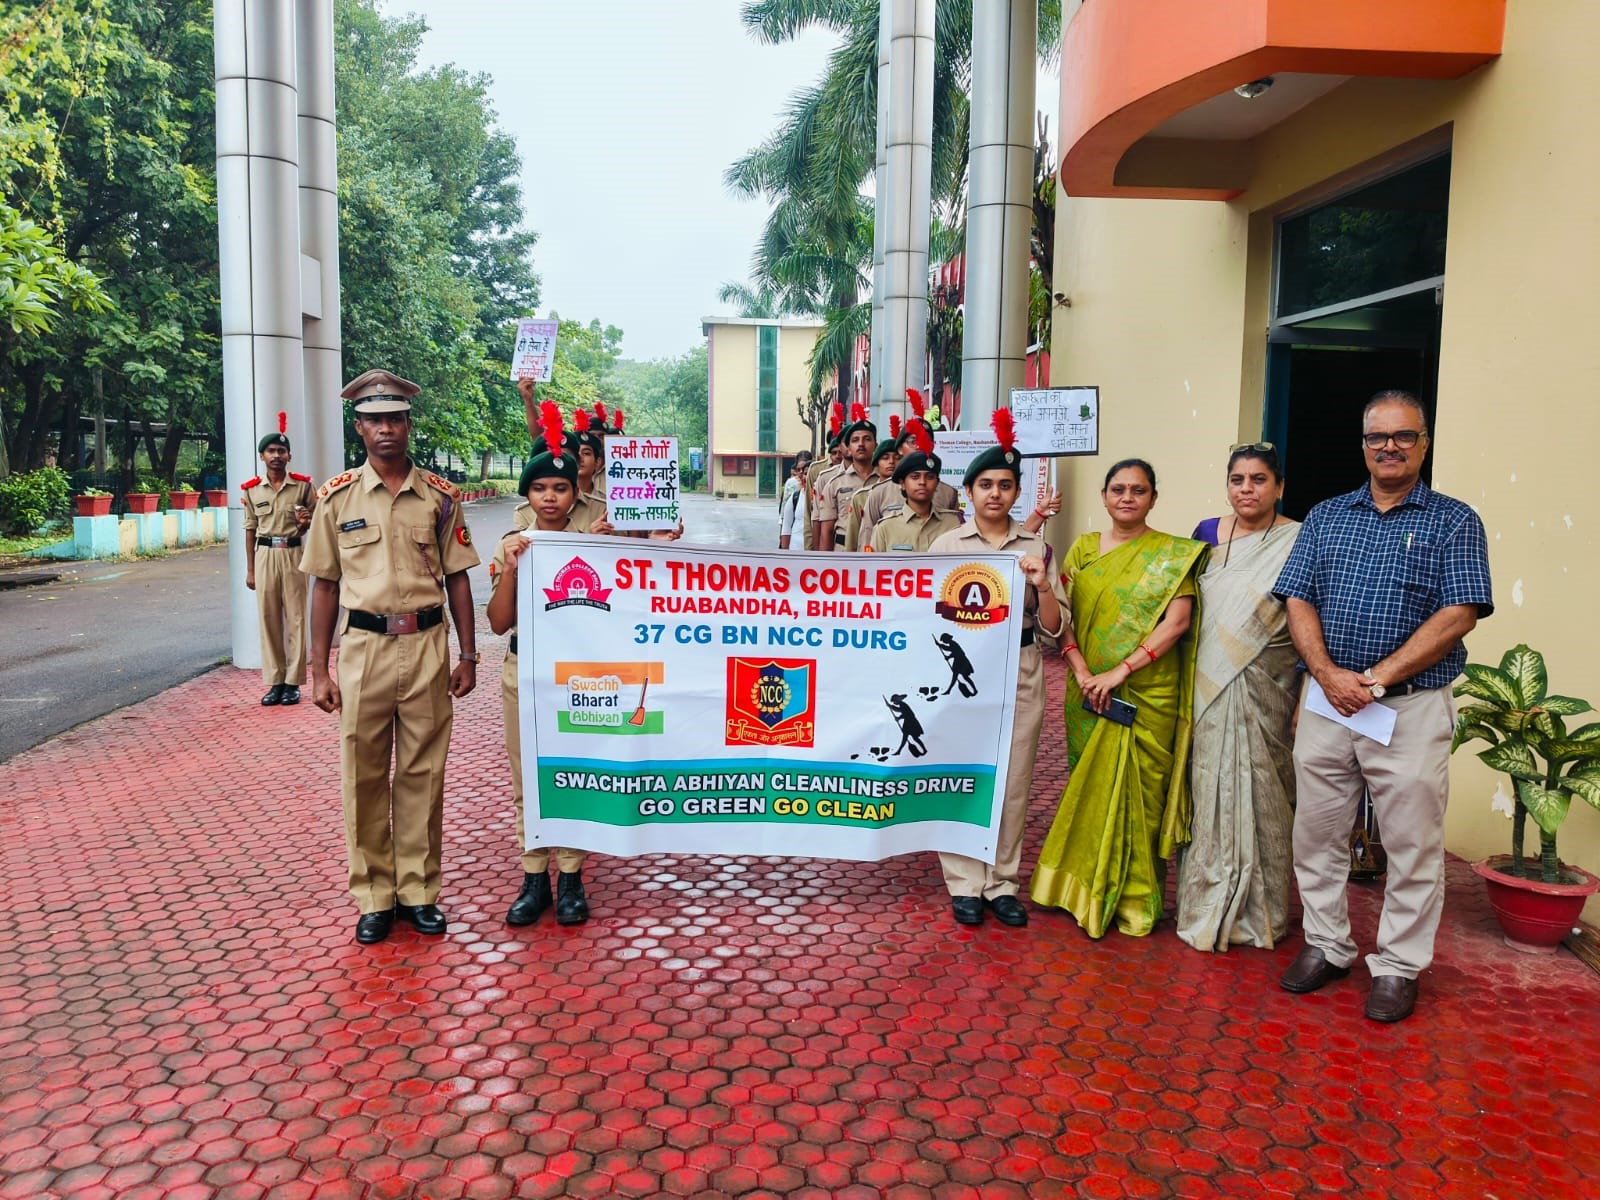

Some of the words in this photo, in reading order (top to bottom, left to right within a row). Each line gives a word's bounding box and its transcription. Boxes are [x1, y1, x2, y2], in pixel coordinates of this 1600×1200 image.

[517, 337, 527, 352] ही
[543, 337, 550, 352] है
[611, 440, 638, 459] सभी
[641, 439, 670, 459] रोगों
[608, 461, 626, 479] की
[649, 460, 677, 483] दवाई
[610, 486, 625, 500] हर
[626, 486, 643, 499] घर
[643, 481, 656, 499] में
[615, 558, 656, 590] ST.
[666, 560, 790, 594] THOMAS
[800, 568, 934, 599] COLLEGE
[948, 571, 975, 596] ACCREDITED
[976, 571, 991, 579] WITH
[964, 584, 984, 606] A
[651, 595, 799, 619] RUABANDHA,
[806, 600, 882, 620] BHILAI
[956, 610, 991, 621] NAAC
[634, 624, 665, 644] 37
[675, 624, 712, 644] CG
[722, 625, 758, 645] BN
[768, 626, 822, 647] NCC
[832, 629, 907, 651] DURG
[571, 679, 619, 691] Swachh
[760, 685, 783, 703] NCC
[571, 693, 619, 707] Bharat
[572, 711, 619, 723] Abhiyan
[554, 771, 668, 794] SWACHHTA
[672, 773, 765, 792] ABHIYAN
[770, 773, 909, 798] CLEANLINESS
[914, 778, 975, 794] DRIVE
[638, 799, 675, 815] GO
[682, 797, 766, 815] GREEN
[772, 798, 809, 815] GO
[816, 800, 895, 821] CLEAN
